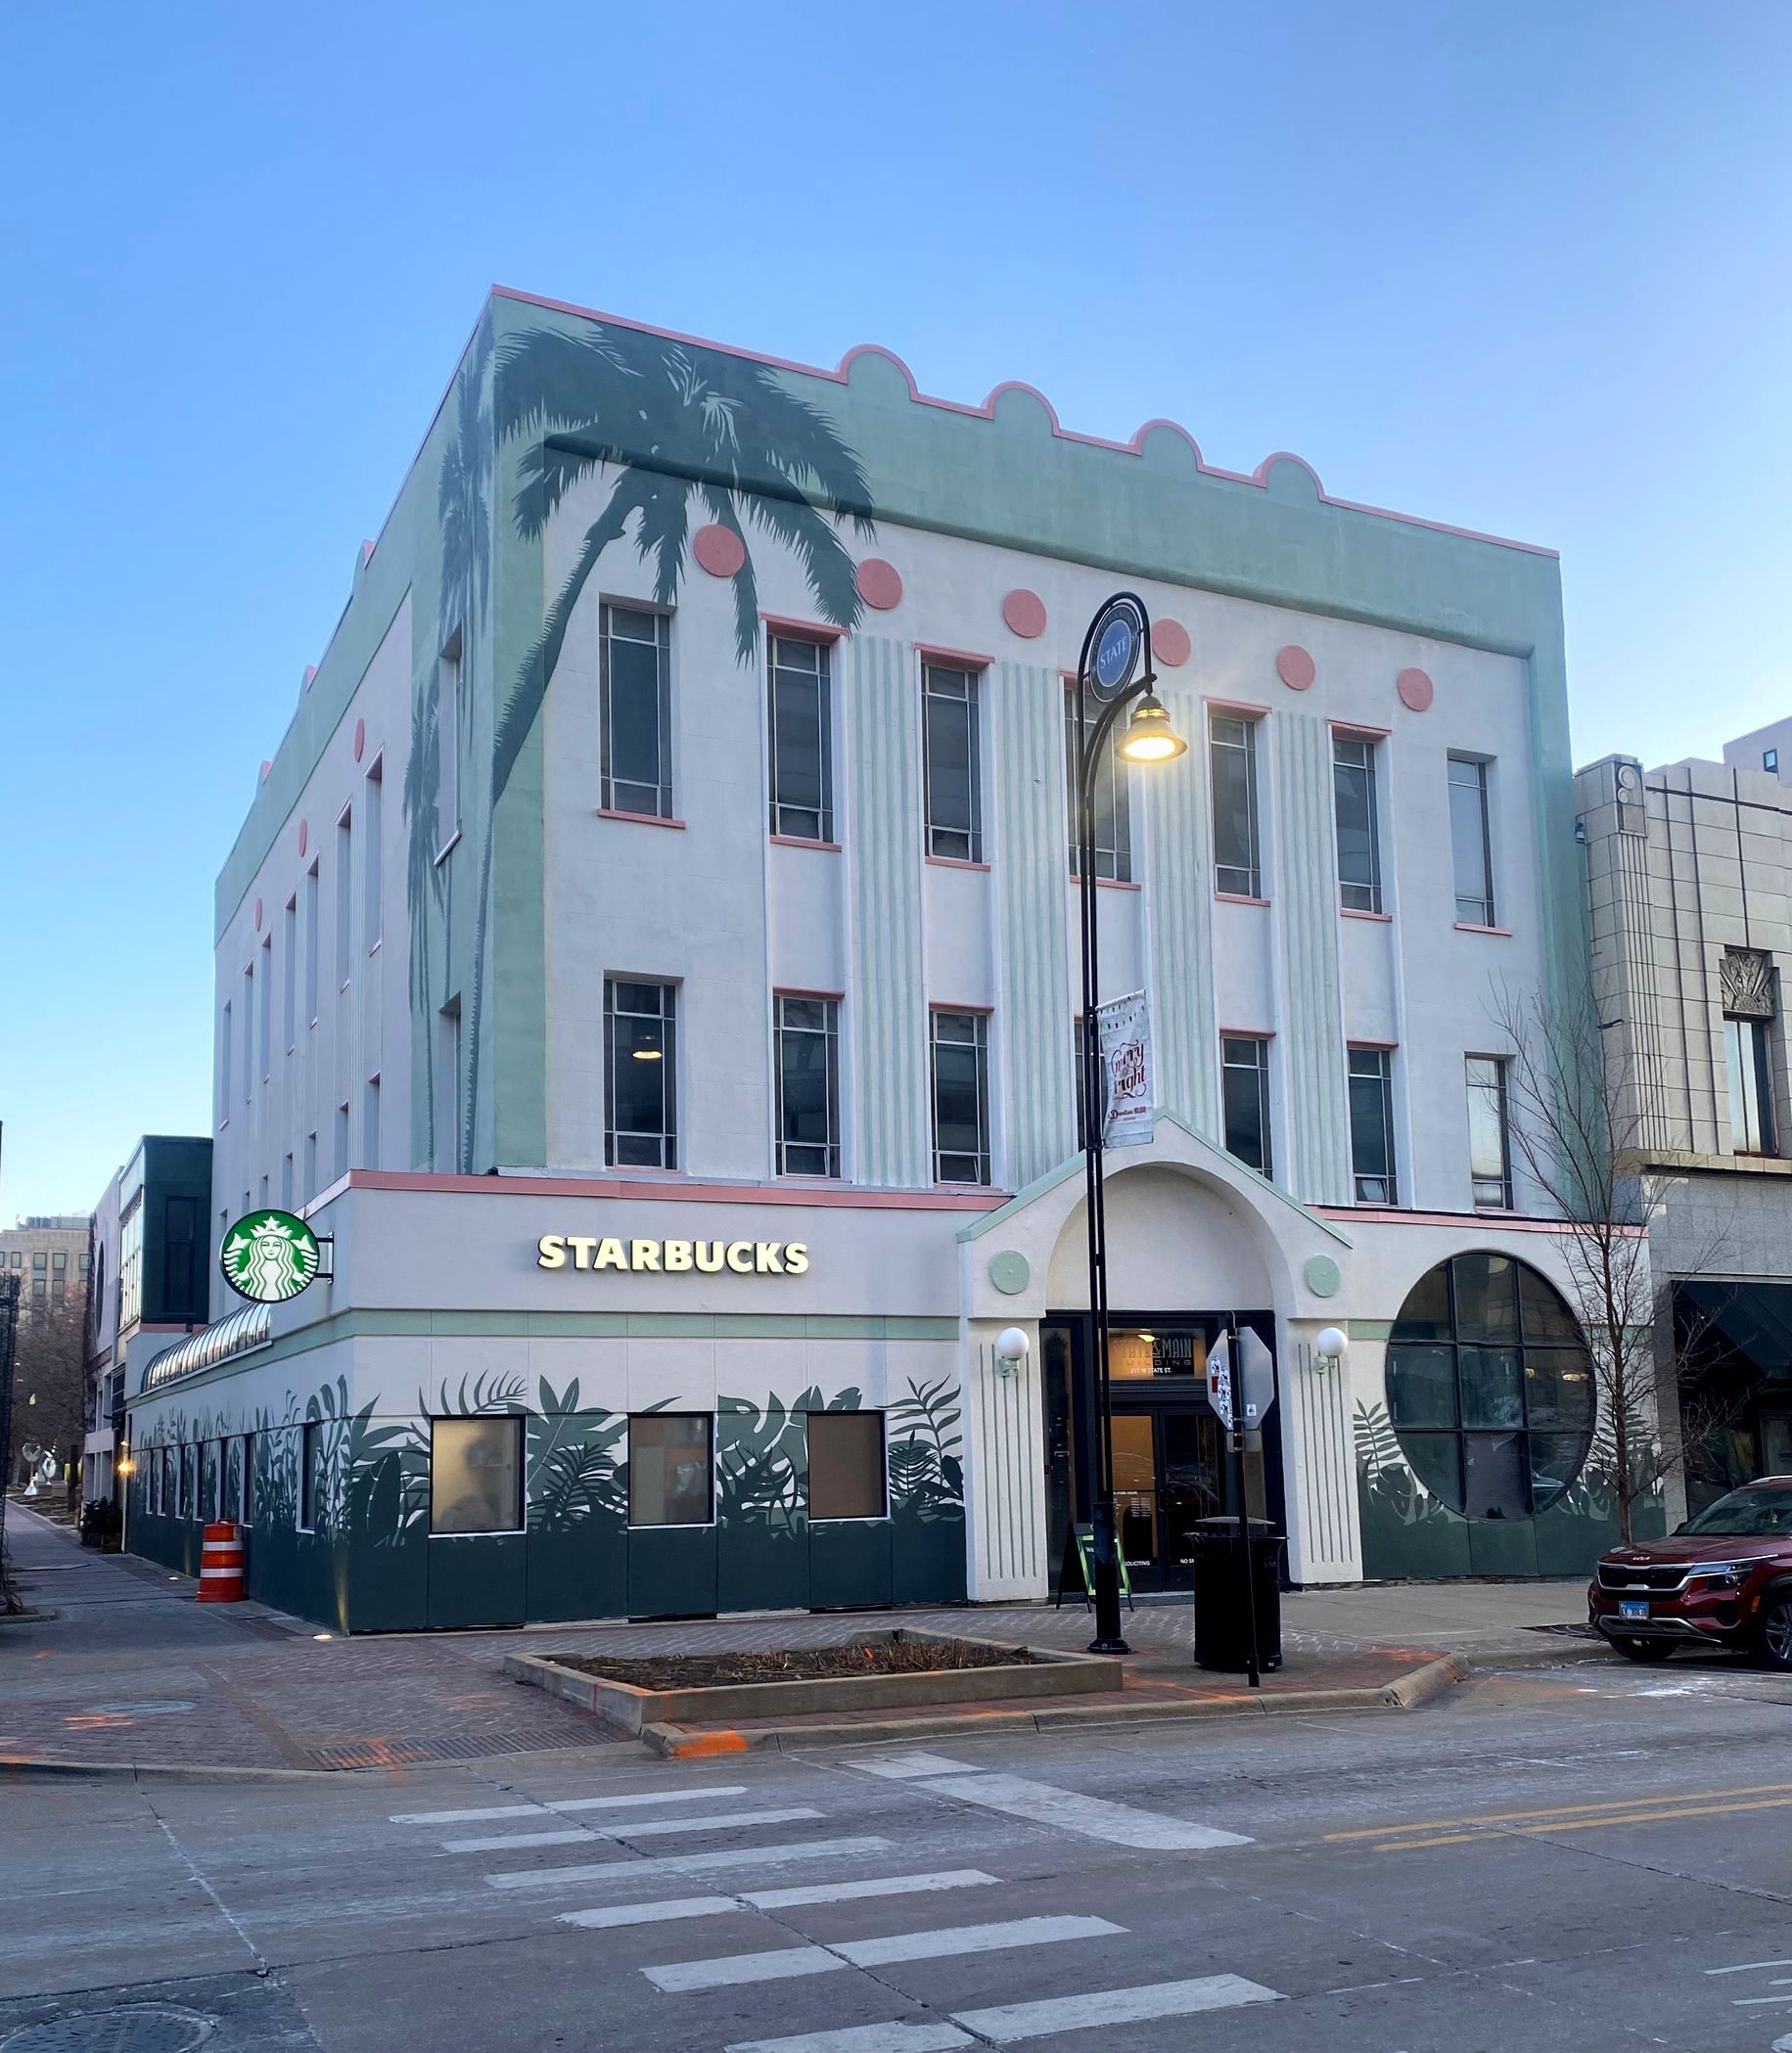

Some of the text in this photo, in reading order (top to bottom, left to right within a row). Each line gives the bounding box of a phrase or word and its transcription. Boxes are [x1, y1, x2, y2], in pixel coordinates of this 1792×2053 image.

[1100, 636, 1127, 669] STATE
[537, 1235, 809, 1275] STARBUCKS
[1162, 1339, 1191, 1357] MAIN
